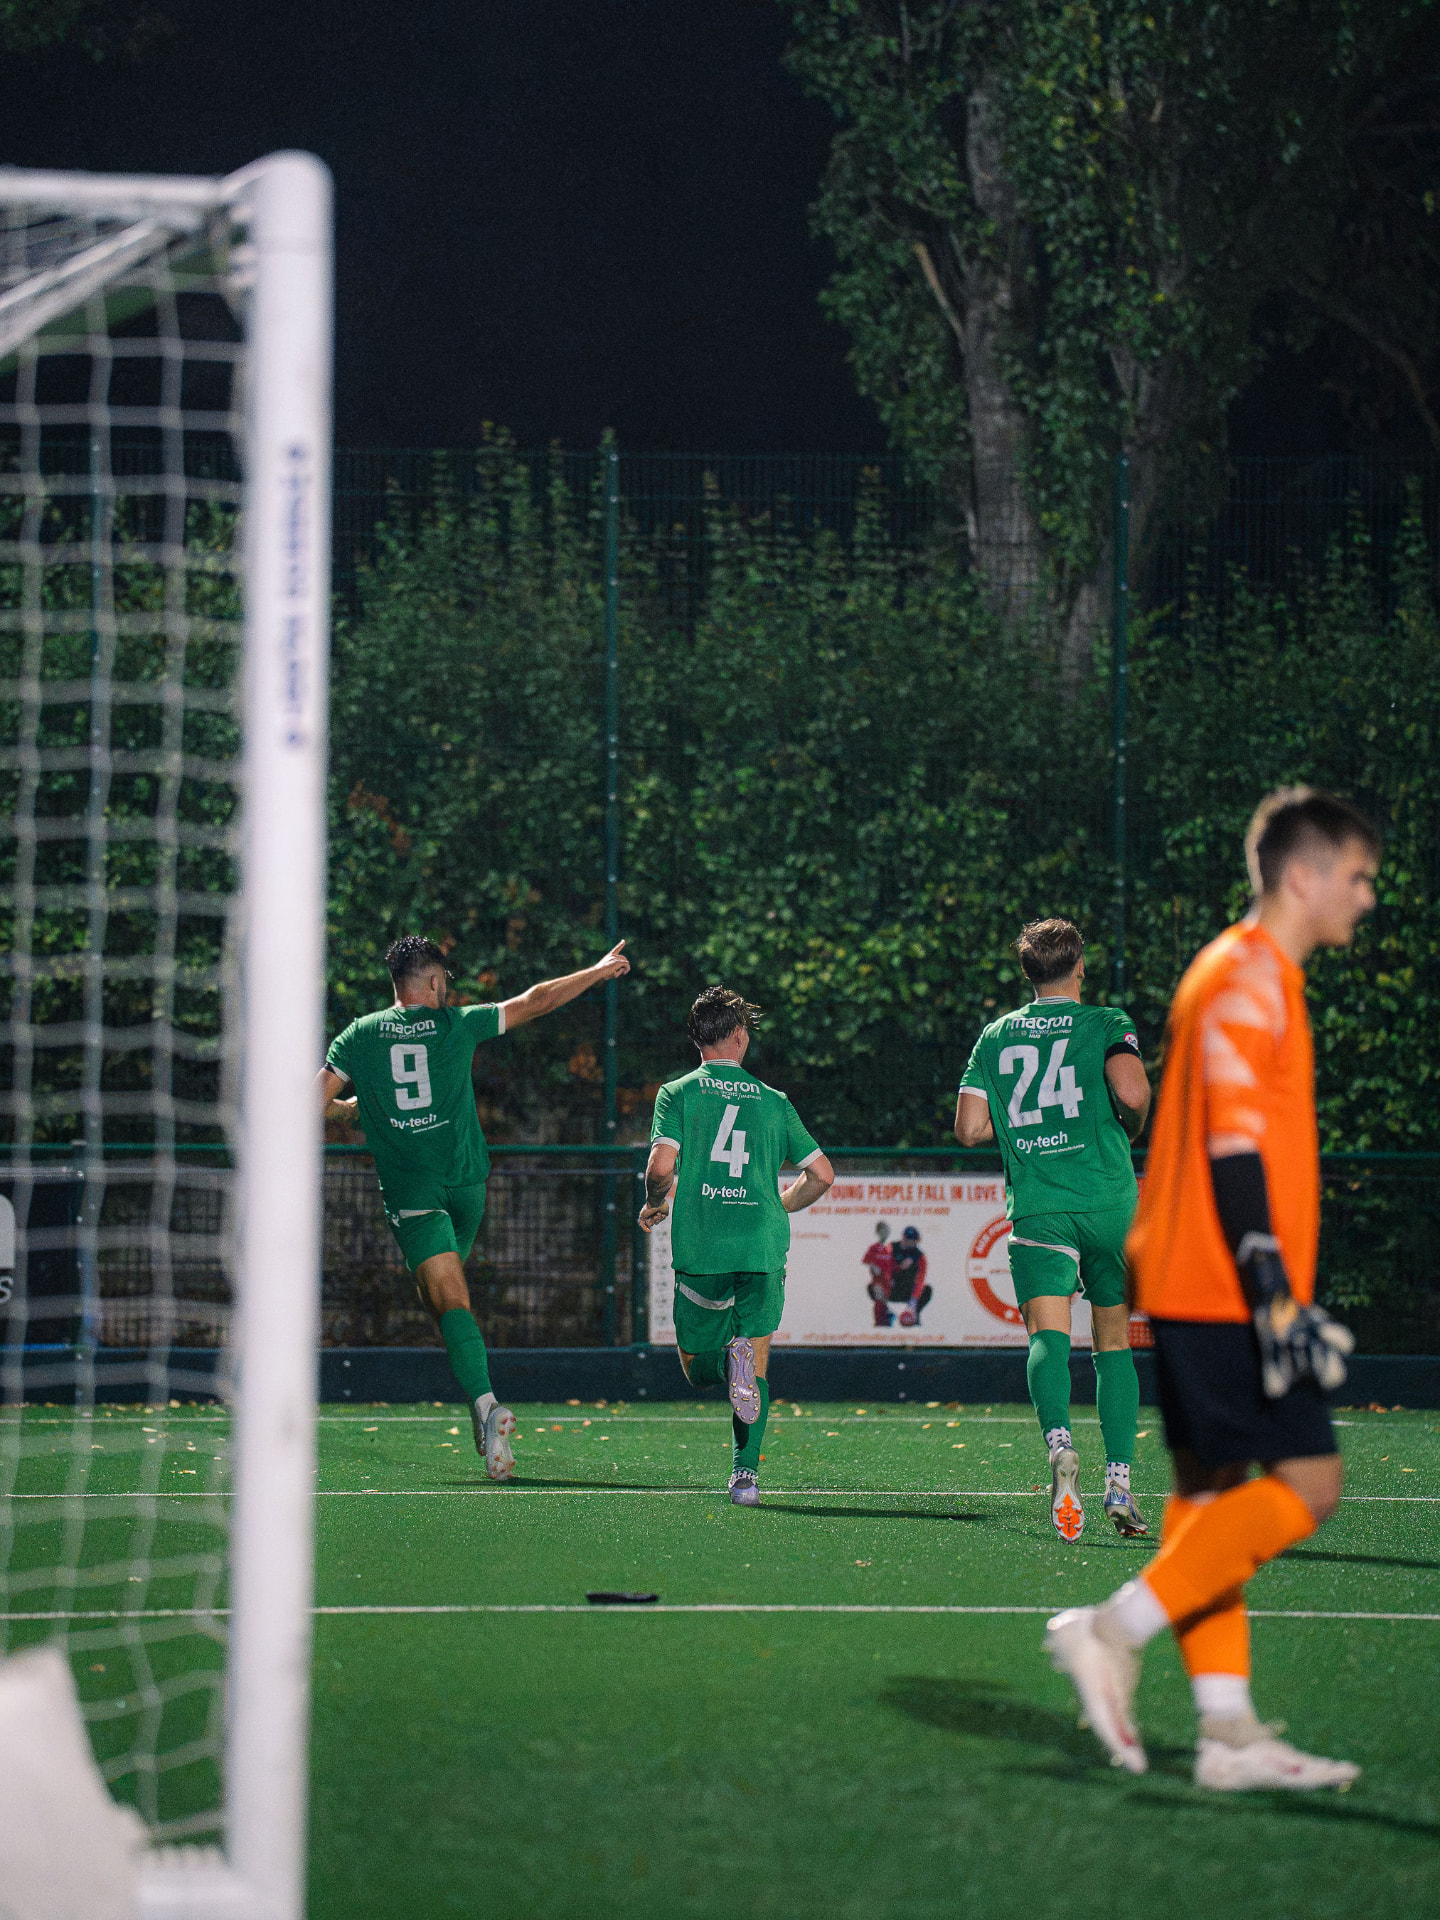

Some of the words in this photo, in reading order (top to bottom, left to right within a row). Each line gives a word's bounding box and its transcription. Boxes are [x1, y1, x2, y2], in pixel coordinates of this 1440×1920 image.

[379, 1019, 436, 1035] macron
[1010, 1015, 1073, 1030] macron
[390, 1043, 432, 1111] 9
[998, 1038, 1084, 1128] 24
[698, 1077, 761, 1095] macron
[389, 1113, 437, 1130] Dy-tech
[710, 1104, 750, 1178] 4
[1016, 1131, 1069, 1153] Dy-tech
[701, 1183, 747, 1200] Dy-tech
[867, 1184, 913, 1201] PEOPLE
[918, 1184, 945, 1201] FALL
[950, 1184, 963, 1201] IN
[967, 1184, 998, 1201] LOVE
